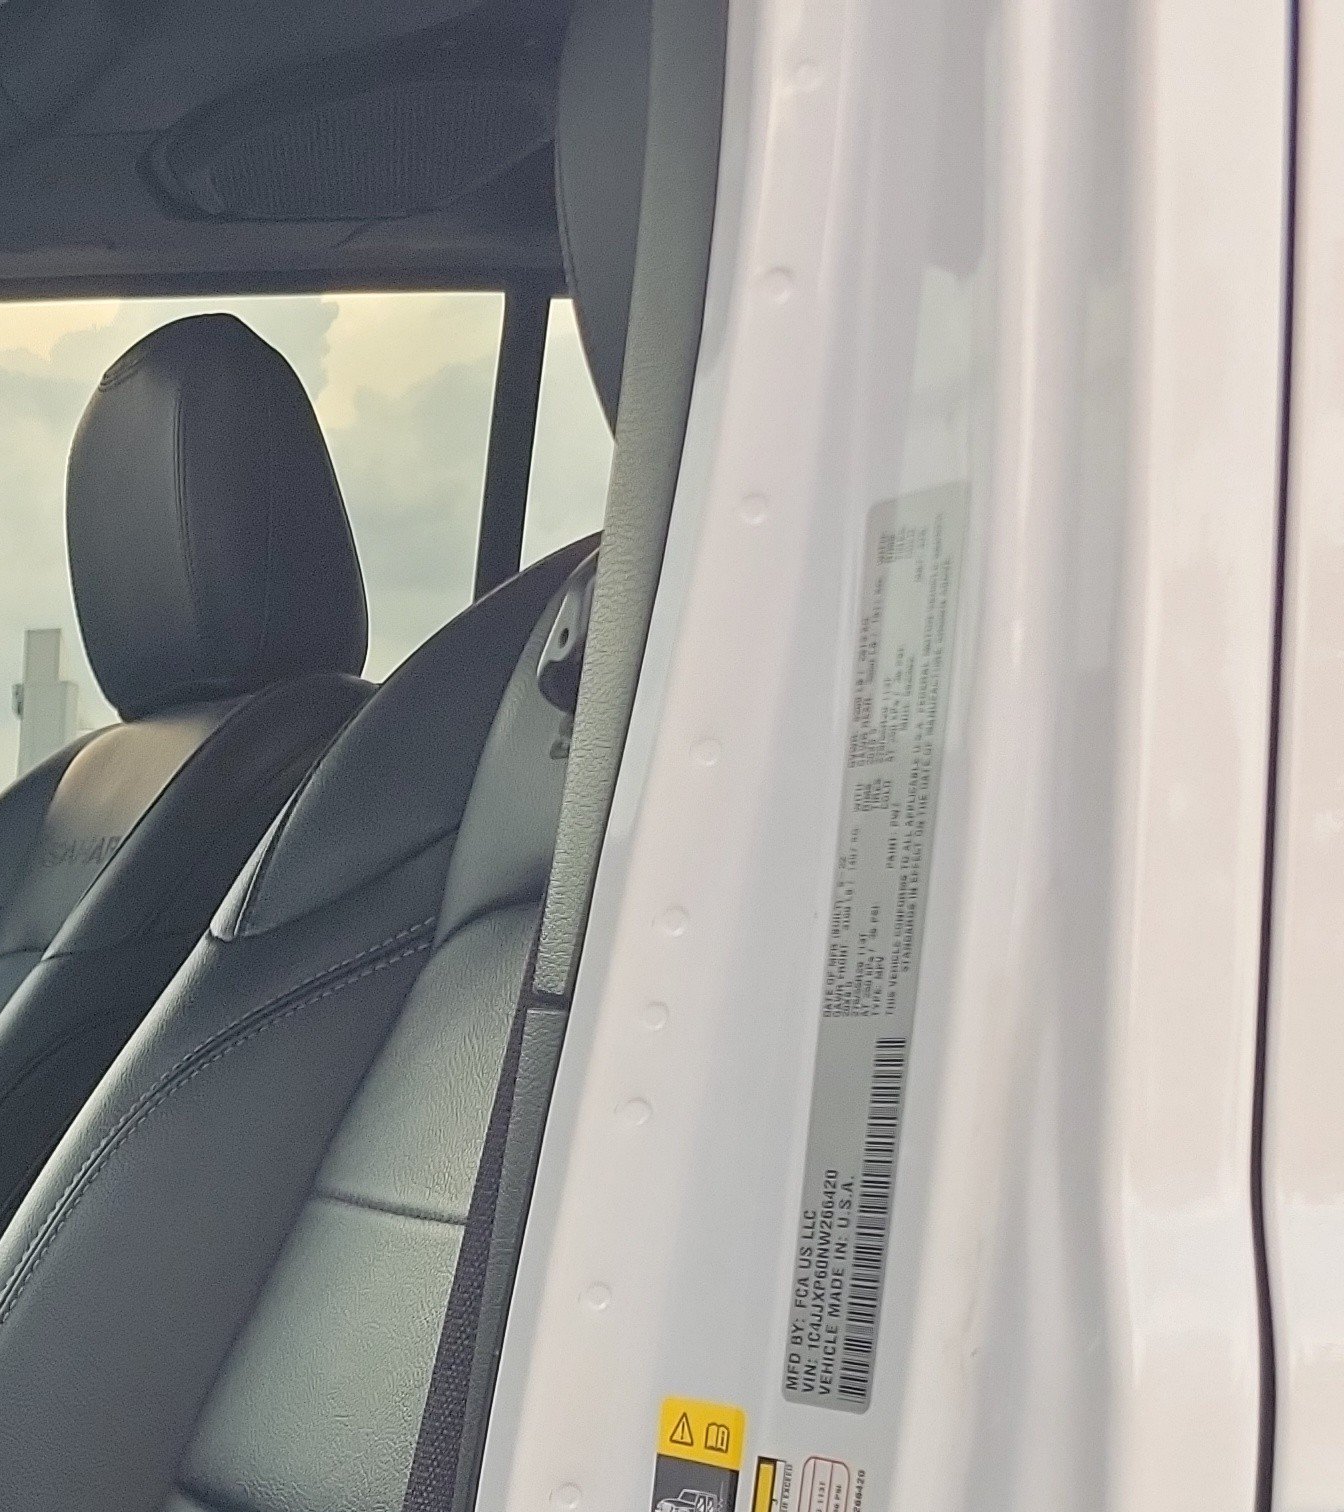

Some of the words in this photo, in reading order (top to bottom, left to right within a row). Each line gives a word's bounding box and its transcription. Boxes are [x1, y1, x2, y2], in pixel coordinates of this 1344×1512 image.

[835, 1174, 854, 1228] U.S.A.
[800, 1209, 816, 1240] LLC
[797, 1245, 812, 1270] US
[806, 1169, 838, 1350] 1C4JJXP60NW266420
[832, 1235, 847, 1260] IN:
[793, 1275, 809, 1308] FCA
[826, 1266, 844, 1317] MADE
[790, 1317, 805, 1345] BY:
[785, 1352, 801, 1390] MFD
[801, 1358, 818, 1394] VIN:
[818, 1323, 838, 1396] VEHICLE
[782, 1463, 792, 1499] EXCEED
